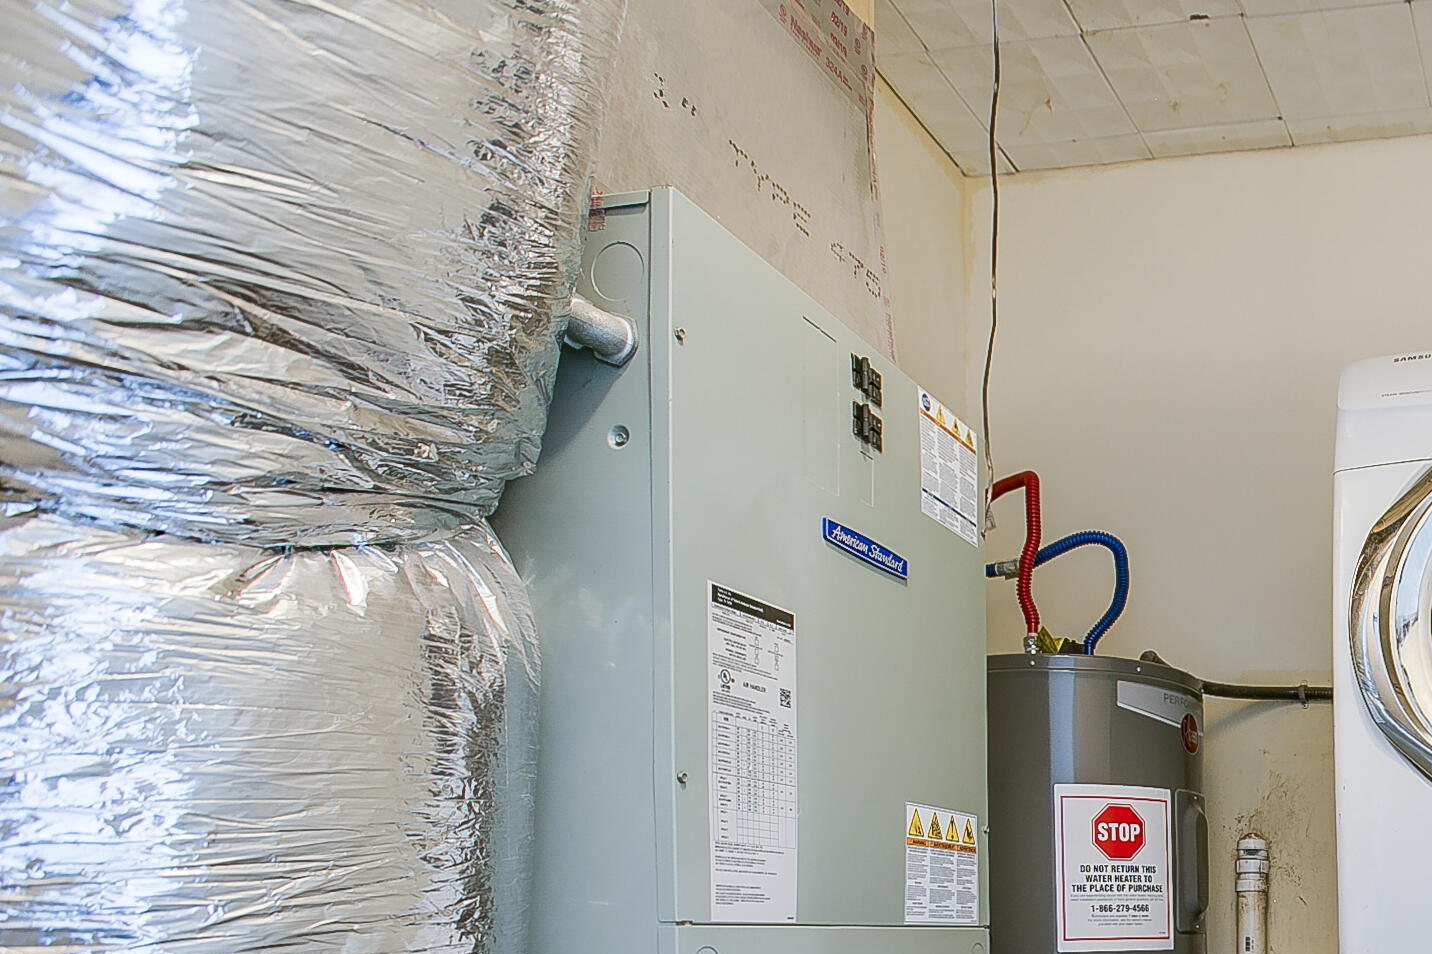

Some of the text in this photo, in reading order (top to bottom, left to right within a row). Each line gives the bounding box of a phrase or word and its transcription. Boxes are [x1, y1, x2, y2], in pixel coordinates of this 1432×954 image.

[831, 11, 848, 36] 02/19
[728, 139, 812, 238] TYPE
[831, 526, 904, 573] American Standard
[1097, 822, 1141, 842] STOP
[1080, 864, 1156, 874] DO NOT RETURN THIS
[1085, 874, 1153, 883] WATER HEATER TO
[1072, 884, 1163, 893] THE PLACE OF PURCHASE
[1090, 904, 1149, 912] 1-866-279-4566
